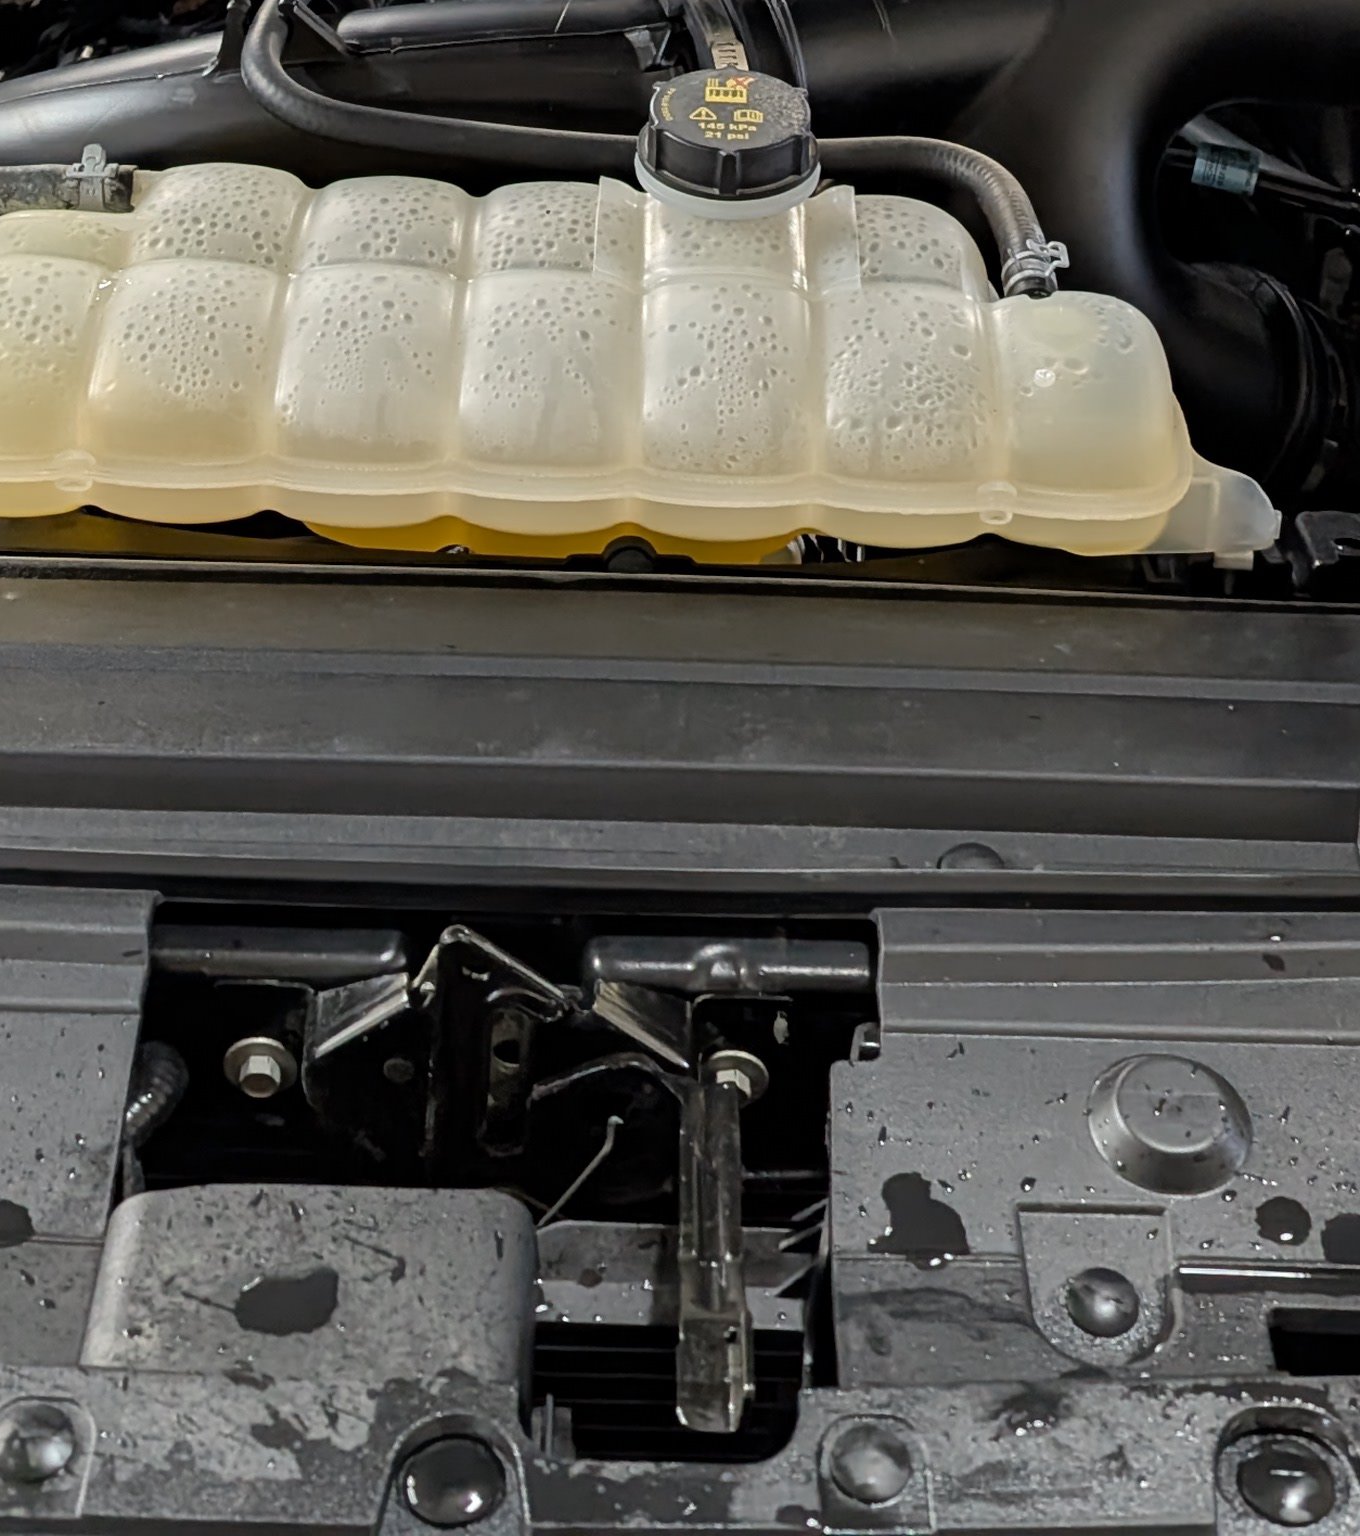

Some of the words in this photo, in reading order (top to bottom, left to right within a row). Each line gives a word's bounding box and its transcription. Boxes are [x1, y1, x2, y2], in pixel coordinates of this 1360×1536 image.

[728, 123, 757, 132] kPa
[704, 130, 722, 139] 21
[726, 132, 750, 141] psi
